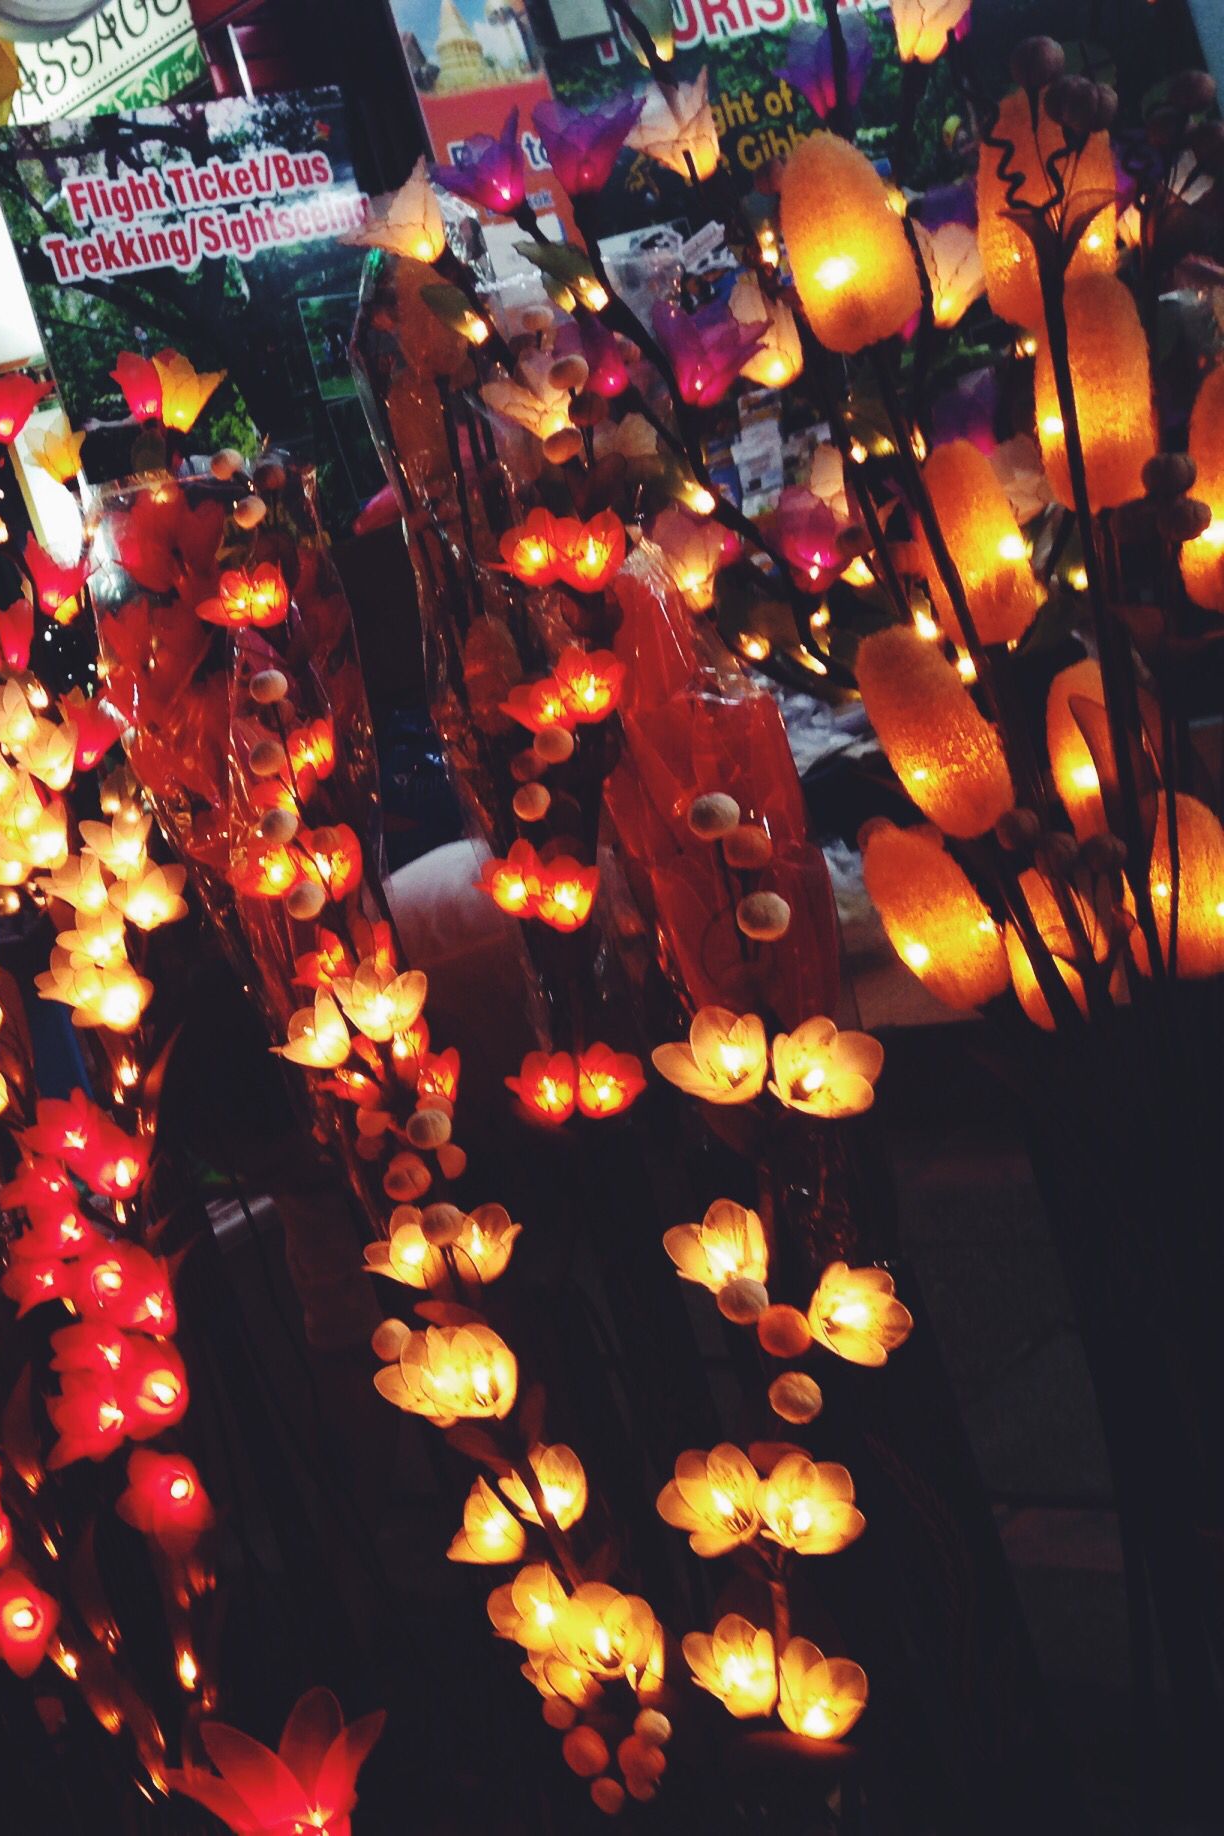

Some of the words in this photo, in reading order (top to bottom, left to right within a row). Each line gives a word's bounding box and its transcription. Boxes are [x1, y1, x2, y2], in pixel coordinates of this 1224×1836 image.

[763, 78, 794, 118] of
[66, 166, 165, 222] Flight
[167, 153, 329, 206] Ticket/Bus
[46, 196, 369, 277] Trekking/Sightseeing
